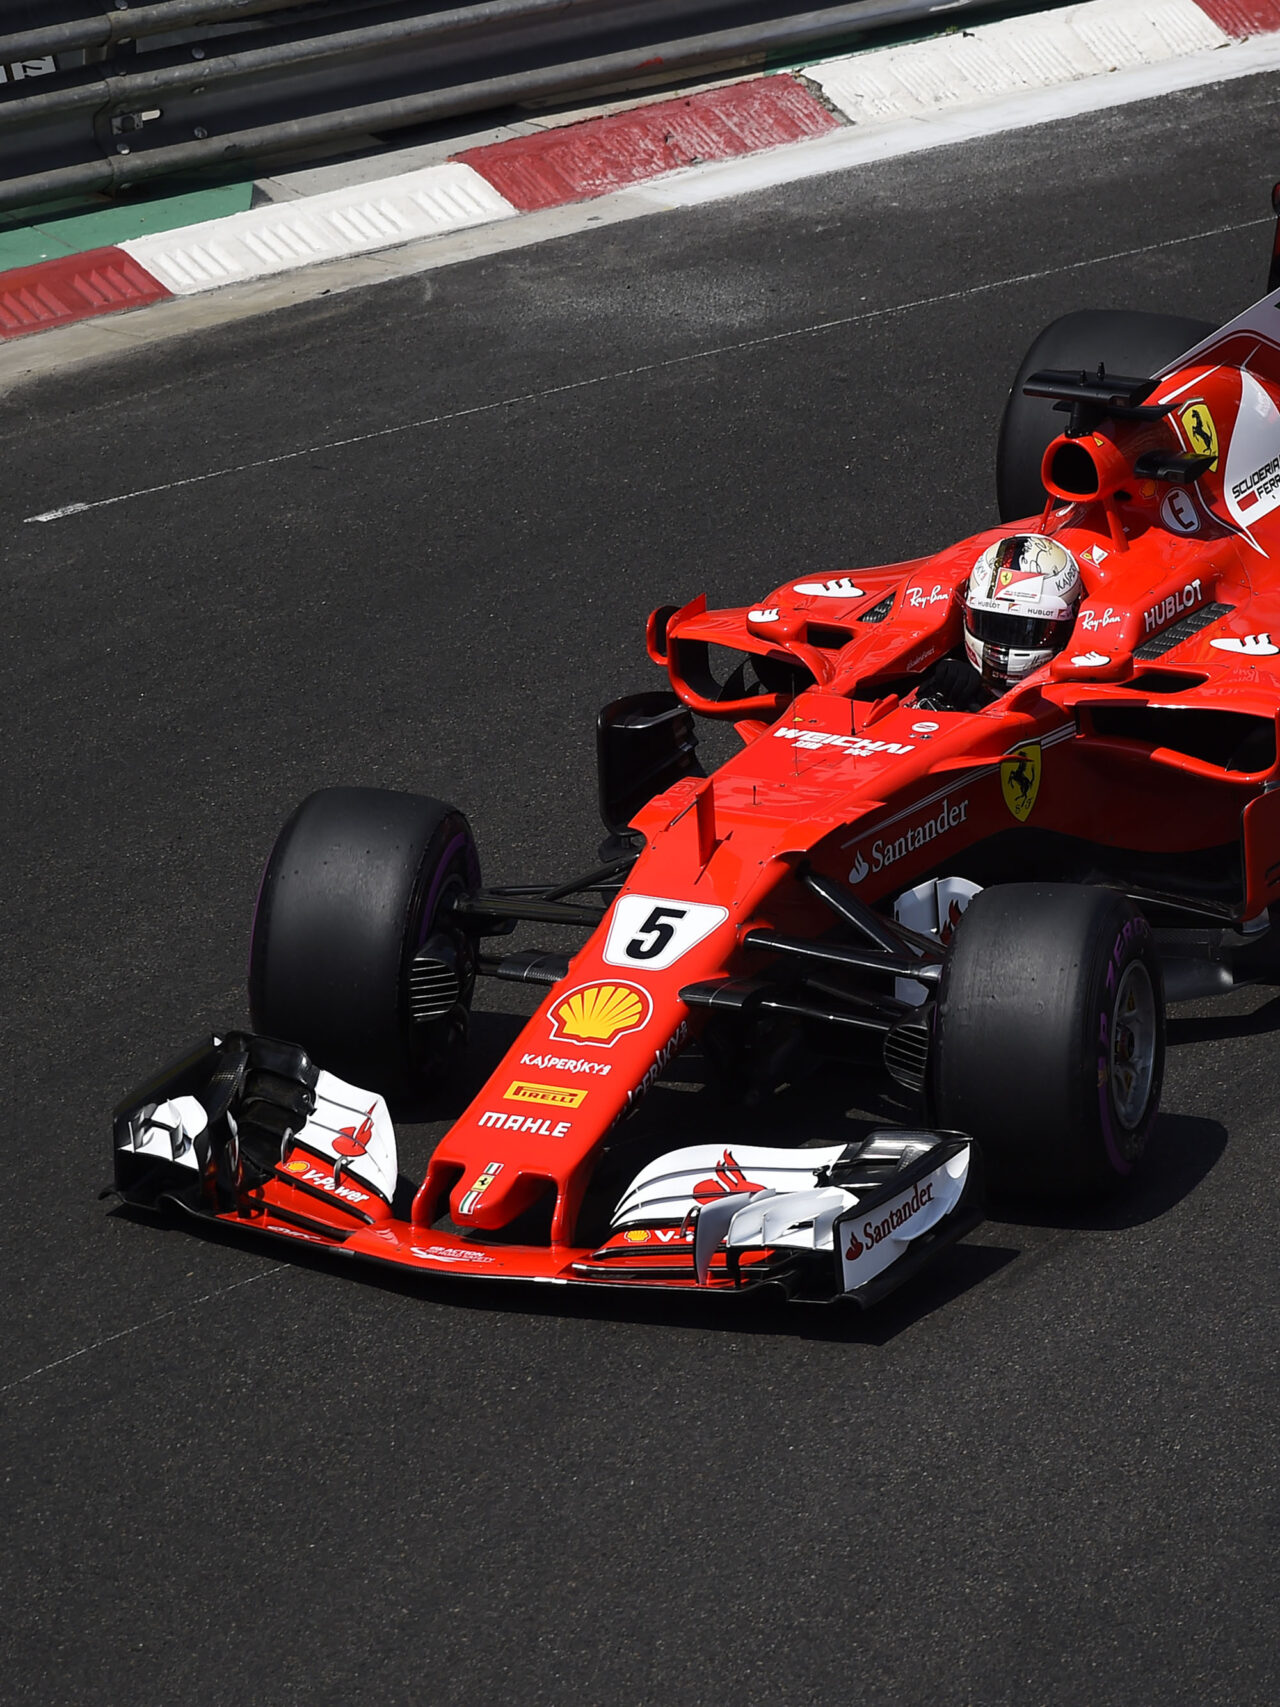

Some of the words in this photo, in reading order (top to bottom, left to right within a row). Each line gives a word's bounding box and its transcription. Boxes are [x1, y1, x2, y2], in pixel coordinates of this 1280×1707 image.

[1232, 457, 1280, 499] SCUDERIA
[906, 584, 950, 609] Ray-Ban
[1027, 608, 1054, 617] HUBLOT
[1143, 578, 1202, 633] HUBLOT
[1078, 607, 1121, 632] Ray-Ban
[773, 727, 916, 755] WEICHAI
[871, 799, 968, 873] Santander
[625, 905, 687, 960] 5
[512, 1085, 579, 1104] PIRELLI
[478, 1111, 572, 1138] MAHLE
[301, 1168, 370, 1204] V-Power
[863, 1178, 934, 1251] Santander
